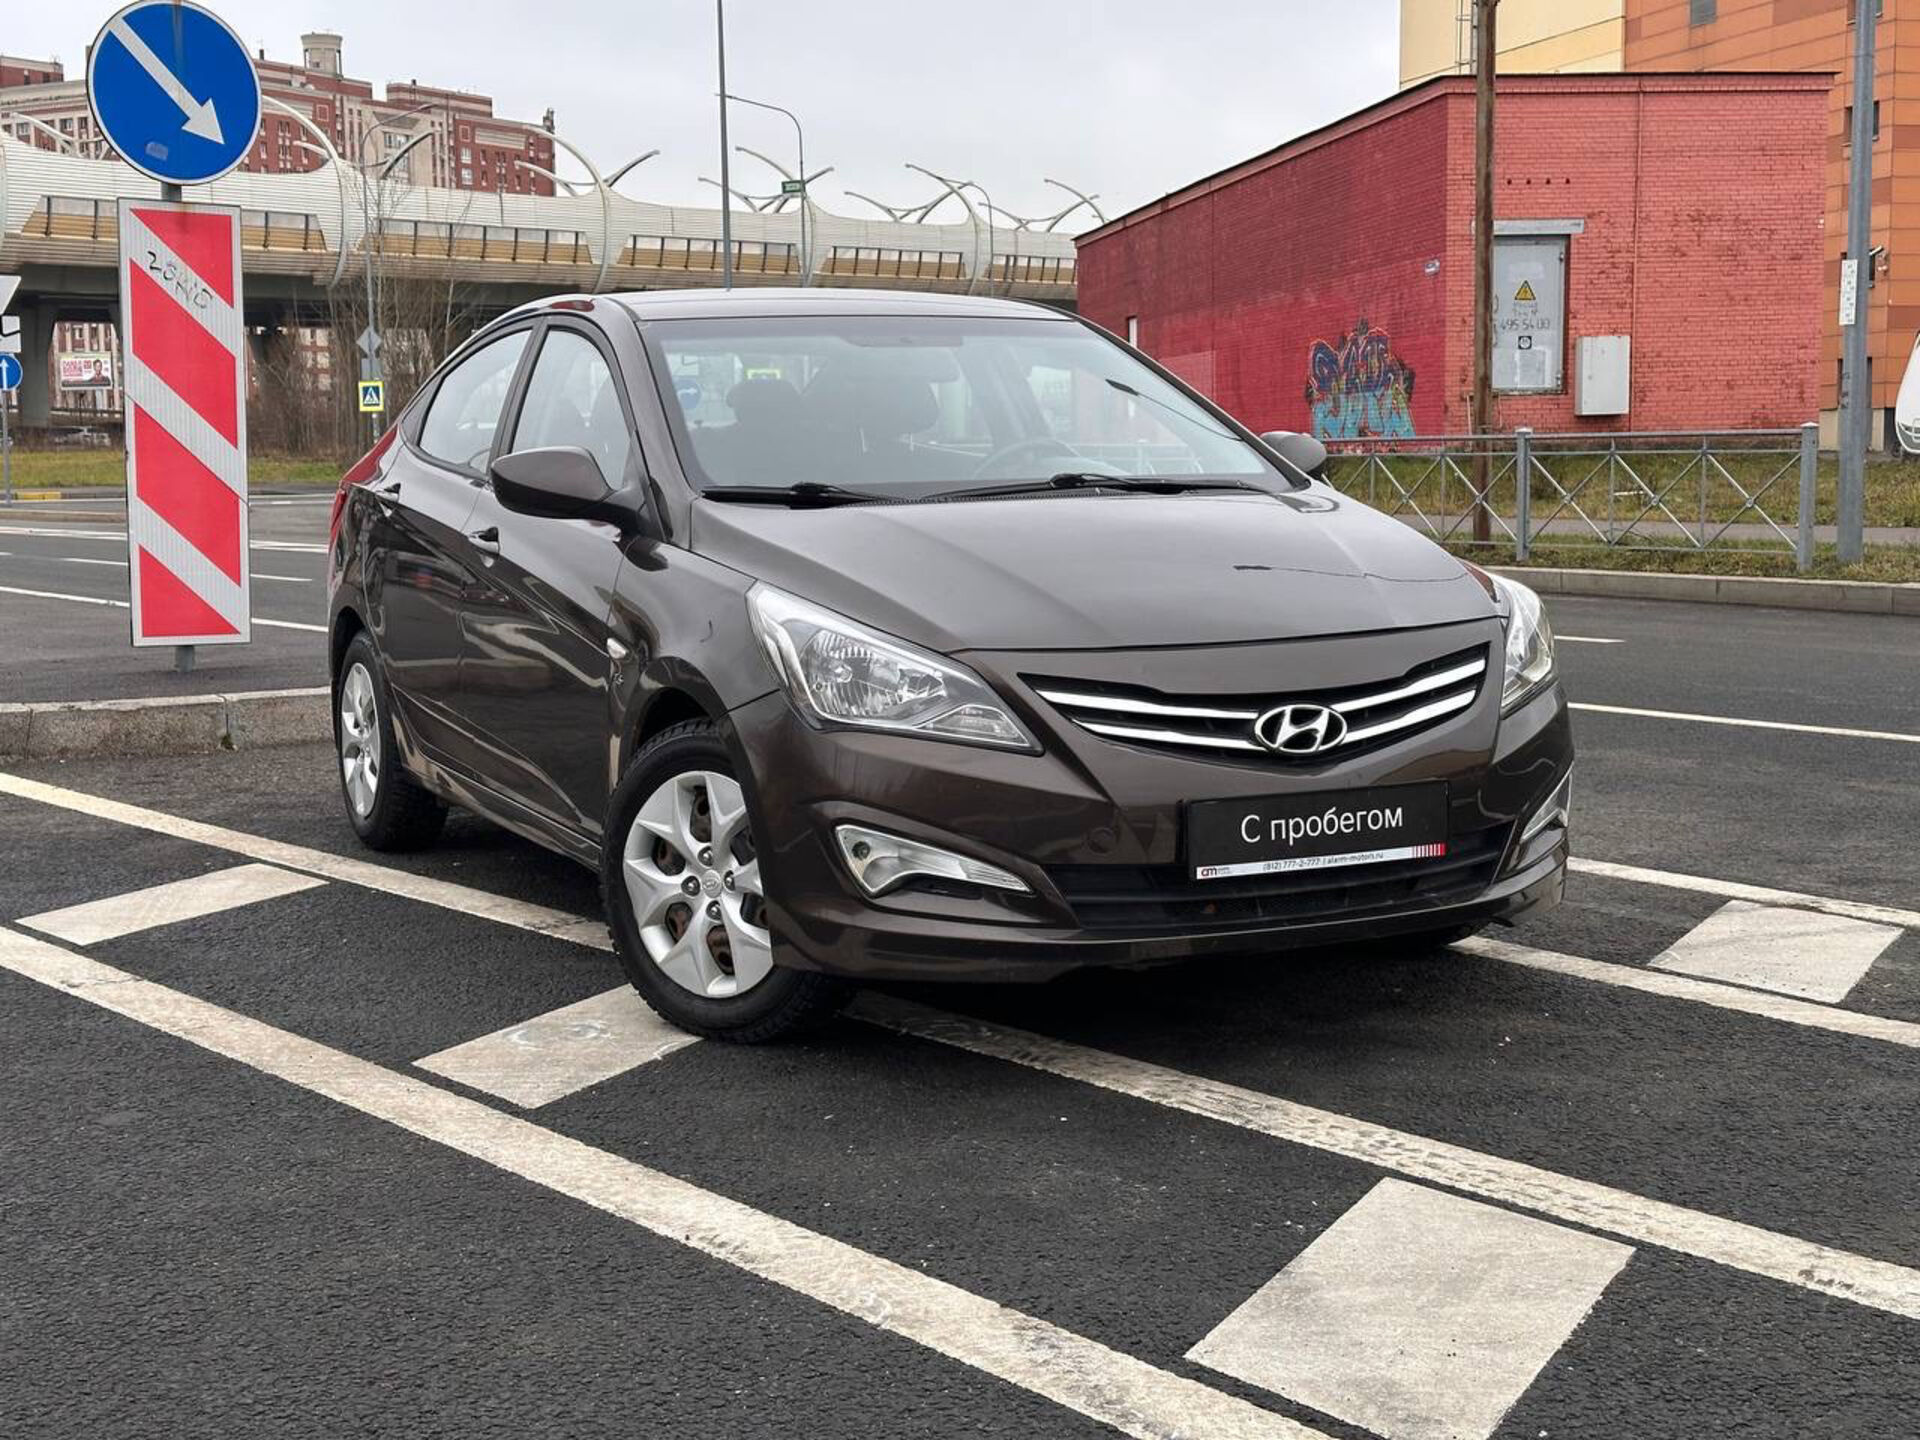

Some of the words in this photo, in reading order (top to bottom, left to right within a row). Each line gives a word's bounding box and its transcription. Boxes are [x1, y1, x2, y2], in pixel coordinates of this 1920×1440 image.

[1241, 814, 1261, 843] С
[1270, 807, 1403, 846] пробегом
[1263, 861, 1282, 872] (812)
[1283, 857, 1321, 870] 777-2-777
[1327, 852, 1384, 865] alarm-motors.ru
